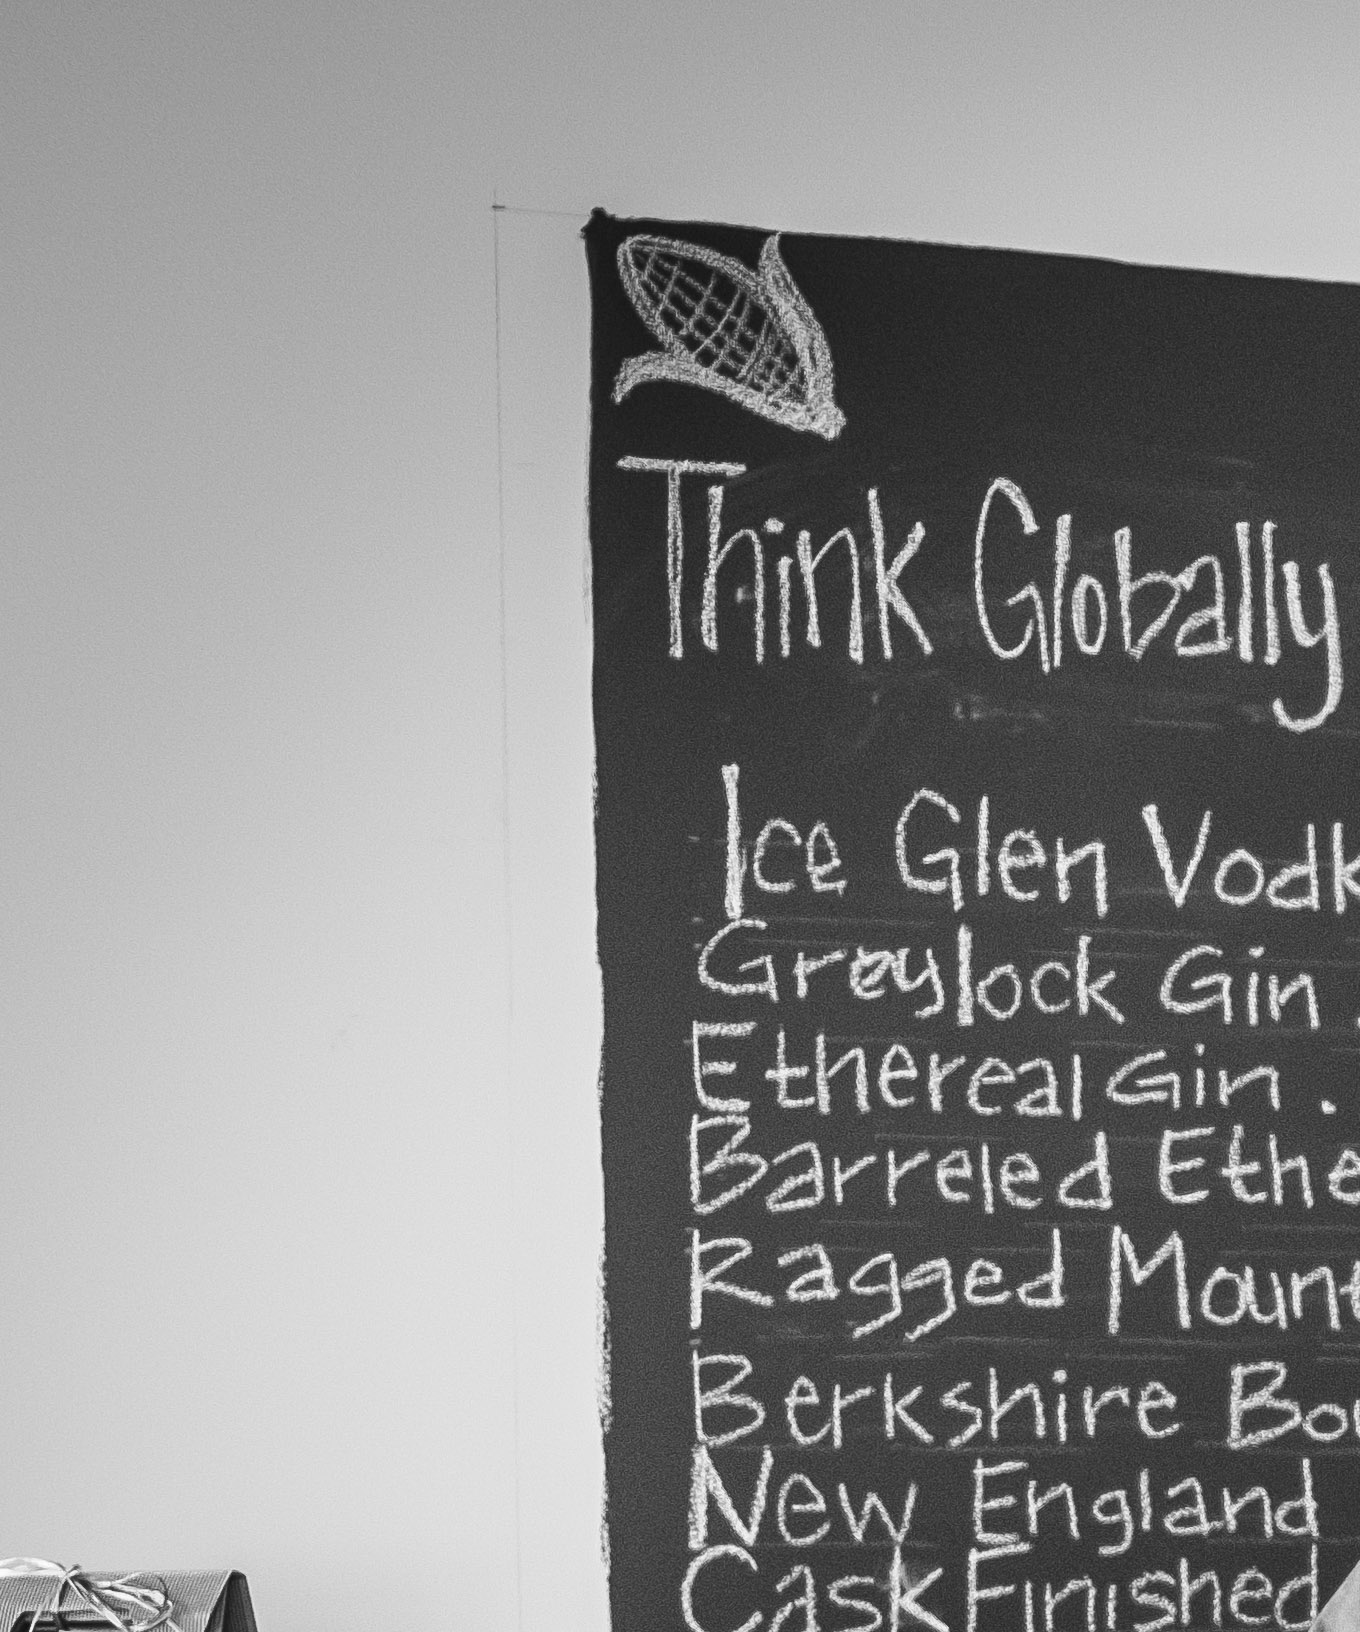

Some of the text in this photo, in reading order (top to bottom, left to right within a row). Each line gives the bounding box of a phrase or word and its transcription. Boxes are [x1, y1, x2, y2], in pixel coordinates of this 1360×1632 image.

[616, 455, 934, 664] Think
[973, 476, 1343, 732] Globally
[720, 764, 848, 920] Ice
[894, 787, 1109, 917] Glen
[697, 917, 1125, 1026] Greylock
[1160, 945, 1321, 1029] Gin
[692, 1020, 1082, 1120] Ethereal
[1106, 1043, 1280, 1111] Gin
[688, 1115, 1113, 1215] Barreled
[689, 1227, 1064, 1341] Ragged
[692, 1350, 1183, 1449] Berkshire
[689, 1446, 919, 1550] New
[972, 1459, 1320, 1556] England
